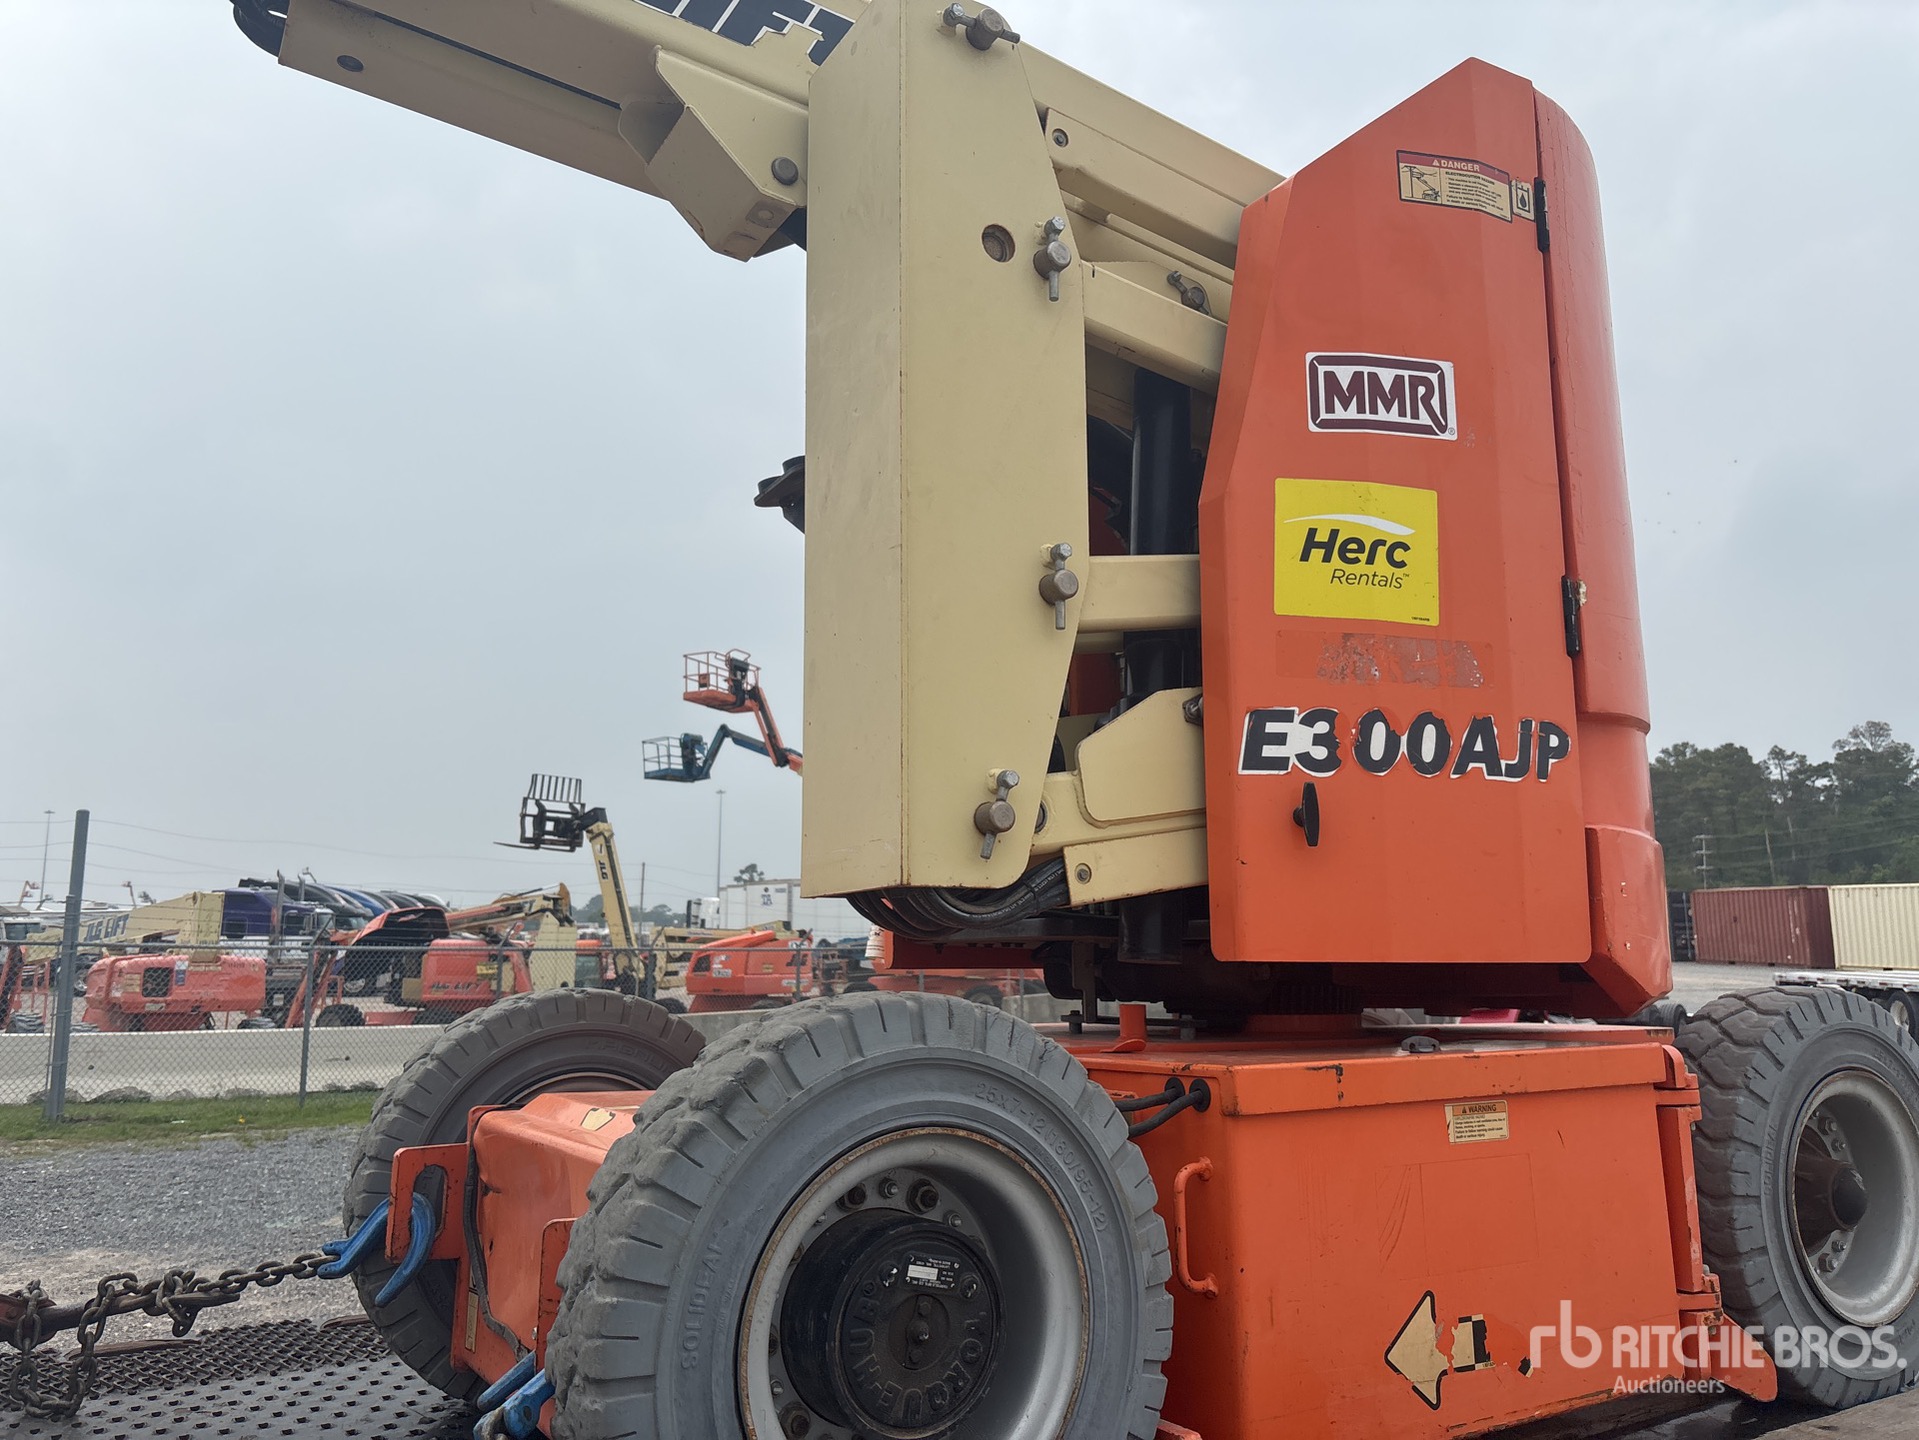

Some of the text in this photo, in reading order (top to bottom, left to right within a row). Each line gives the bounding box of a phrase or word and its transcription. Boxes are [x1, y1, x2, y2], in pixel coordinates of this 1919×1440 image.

[1441, 160, 1480, 172] DANGER
[1323, 370, 1448, 435] MMR
[1299, 527, 1411, 569] Herc
[1330, 568, 1403, 589] Rentals
[1238, 706, 1572, 783] E300AJP
[85, 913, 130, 942] JLG LIFT
[1468, 1104, 1497, 1114] WARNING
